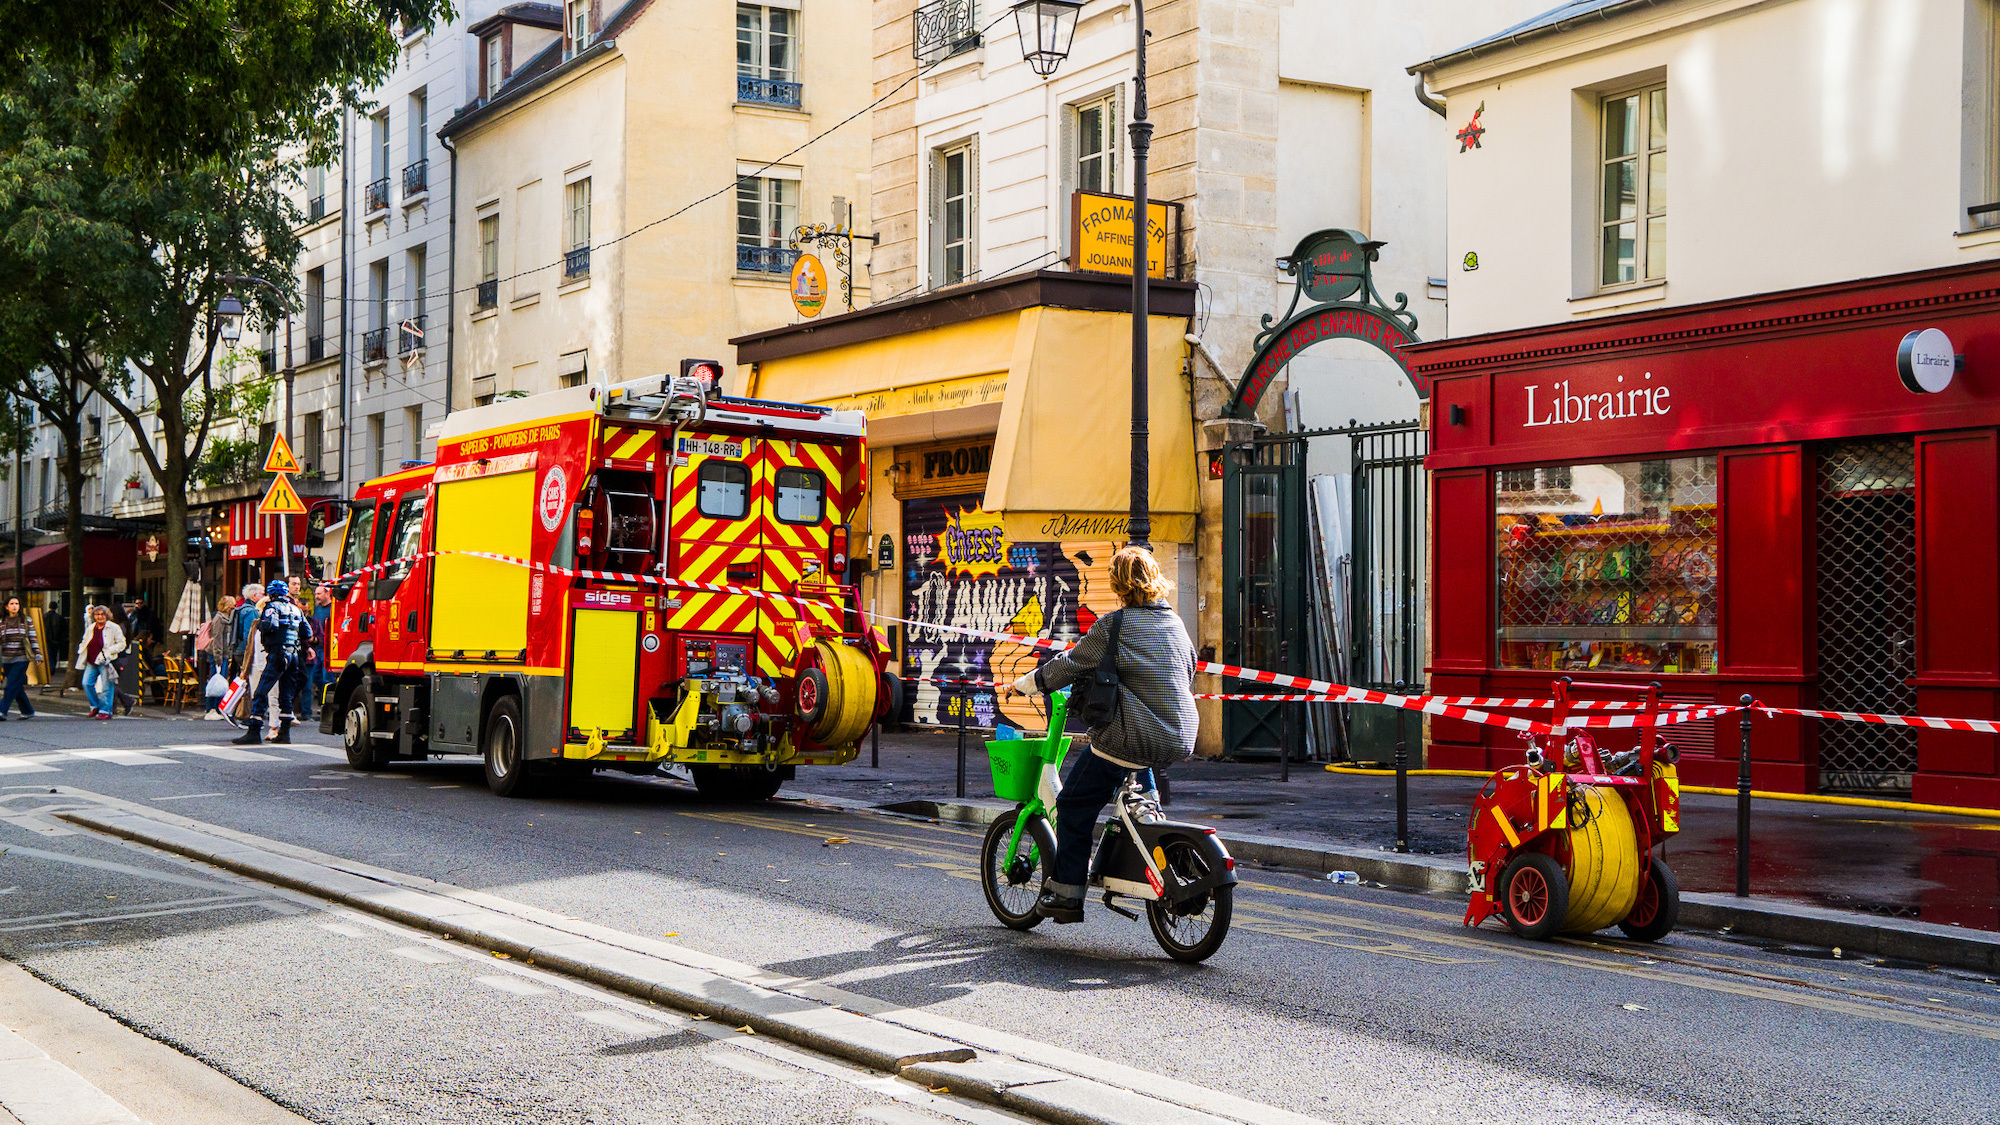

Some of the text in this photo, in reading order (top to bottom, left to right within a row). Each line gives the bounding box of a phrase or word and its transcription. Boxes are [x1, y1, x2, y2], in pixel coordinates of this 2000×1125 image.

[1082, 206, 1165, 244] FROMAER
[1097, 231, 1149, 248] AFFINE
[1087, 253, 1158, 271] JOUANNLT
[1242, 337, 1292, 409] MARCHE
[1291, 319, 1317, 351] DES
[1320, 312, 1382, 341] ENFANTS
[1916, 353, 1950, 367] Librairie
[1522, 371, 1672, 427] Librairie
[459, 424, 561, 457] SAPEURS POMPIERS DE PARIS
[585, 591, 631, 603] sides
